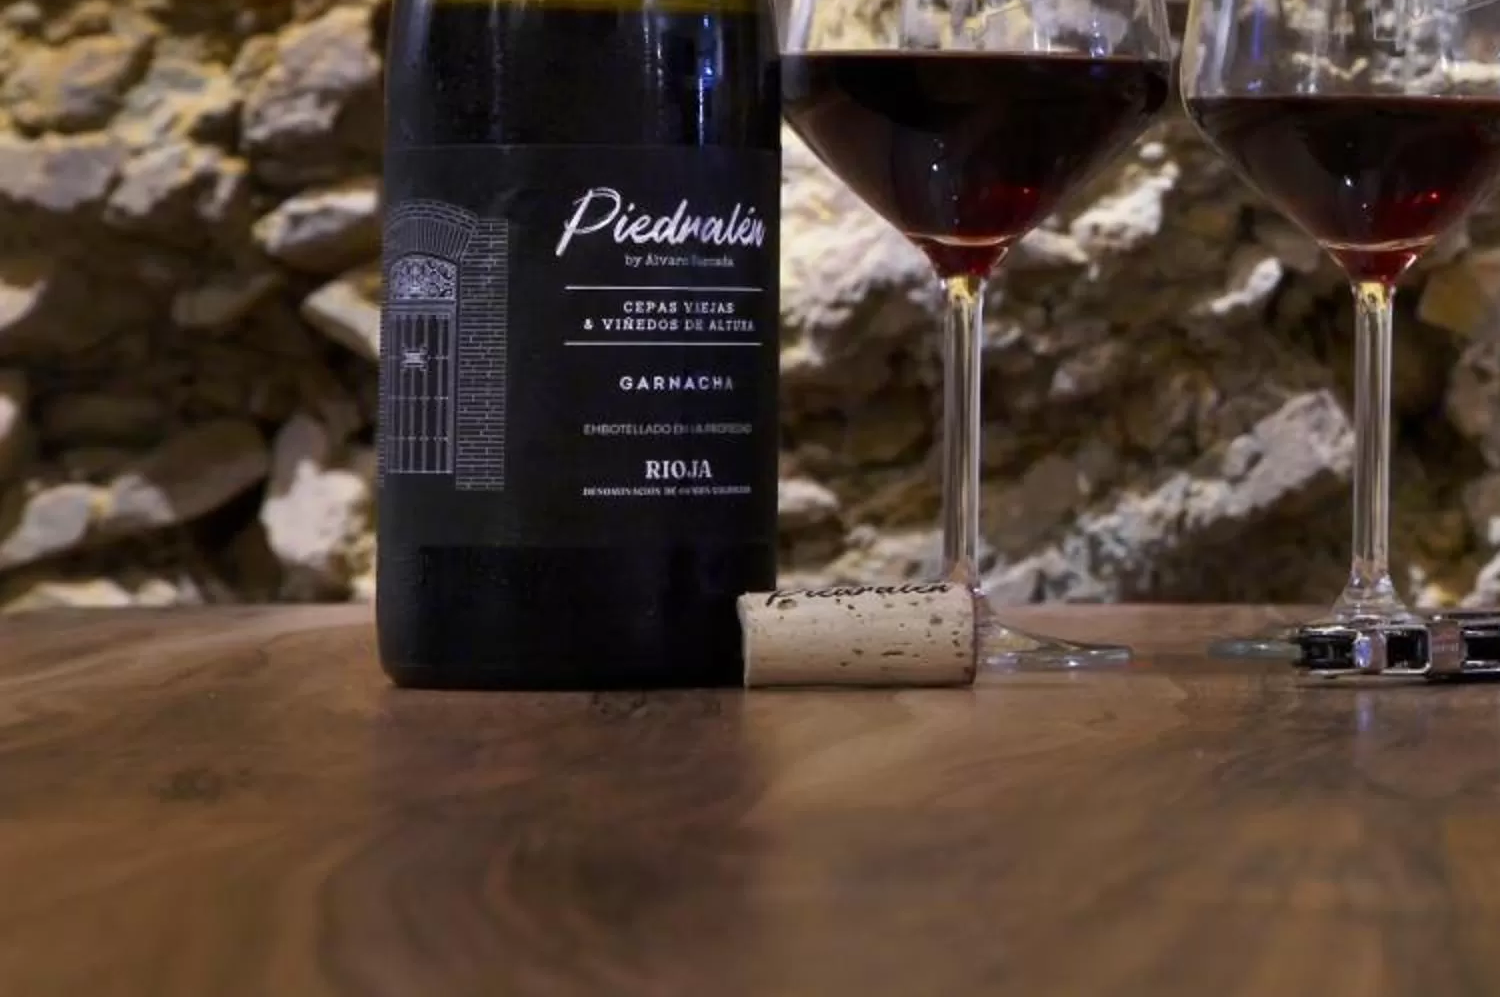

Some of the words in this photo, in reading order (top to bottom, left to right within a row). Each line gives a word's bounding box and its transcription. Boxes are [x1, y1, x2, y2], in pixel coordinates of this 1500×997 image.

[624, 255, 642, 267] by
[623, 301, 677, 314] CEPAS
[683, 302, 735, 314] VIEJAS
[583, 318, 594, 330] &
[602, 317, 679, 331] VIÑEDOS
[684, 319, 703, 331] DE
[619, 376, 734, 390] GARNACHA
[645, 459, 713, 479] RIOJA
